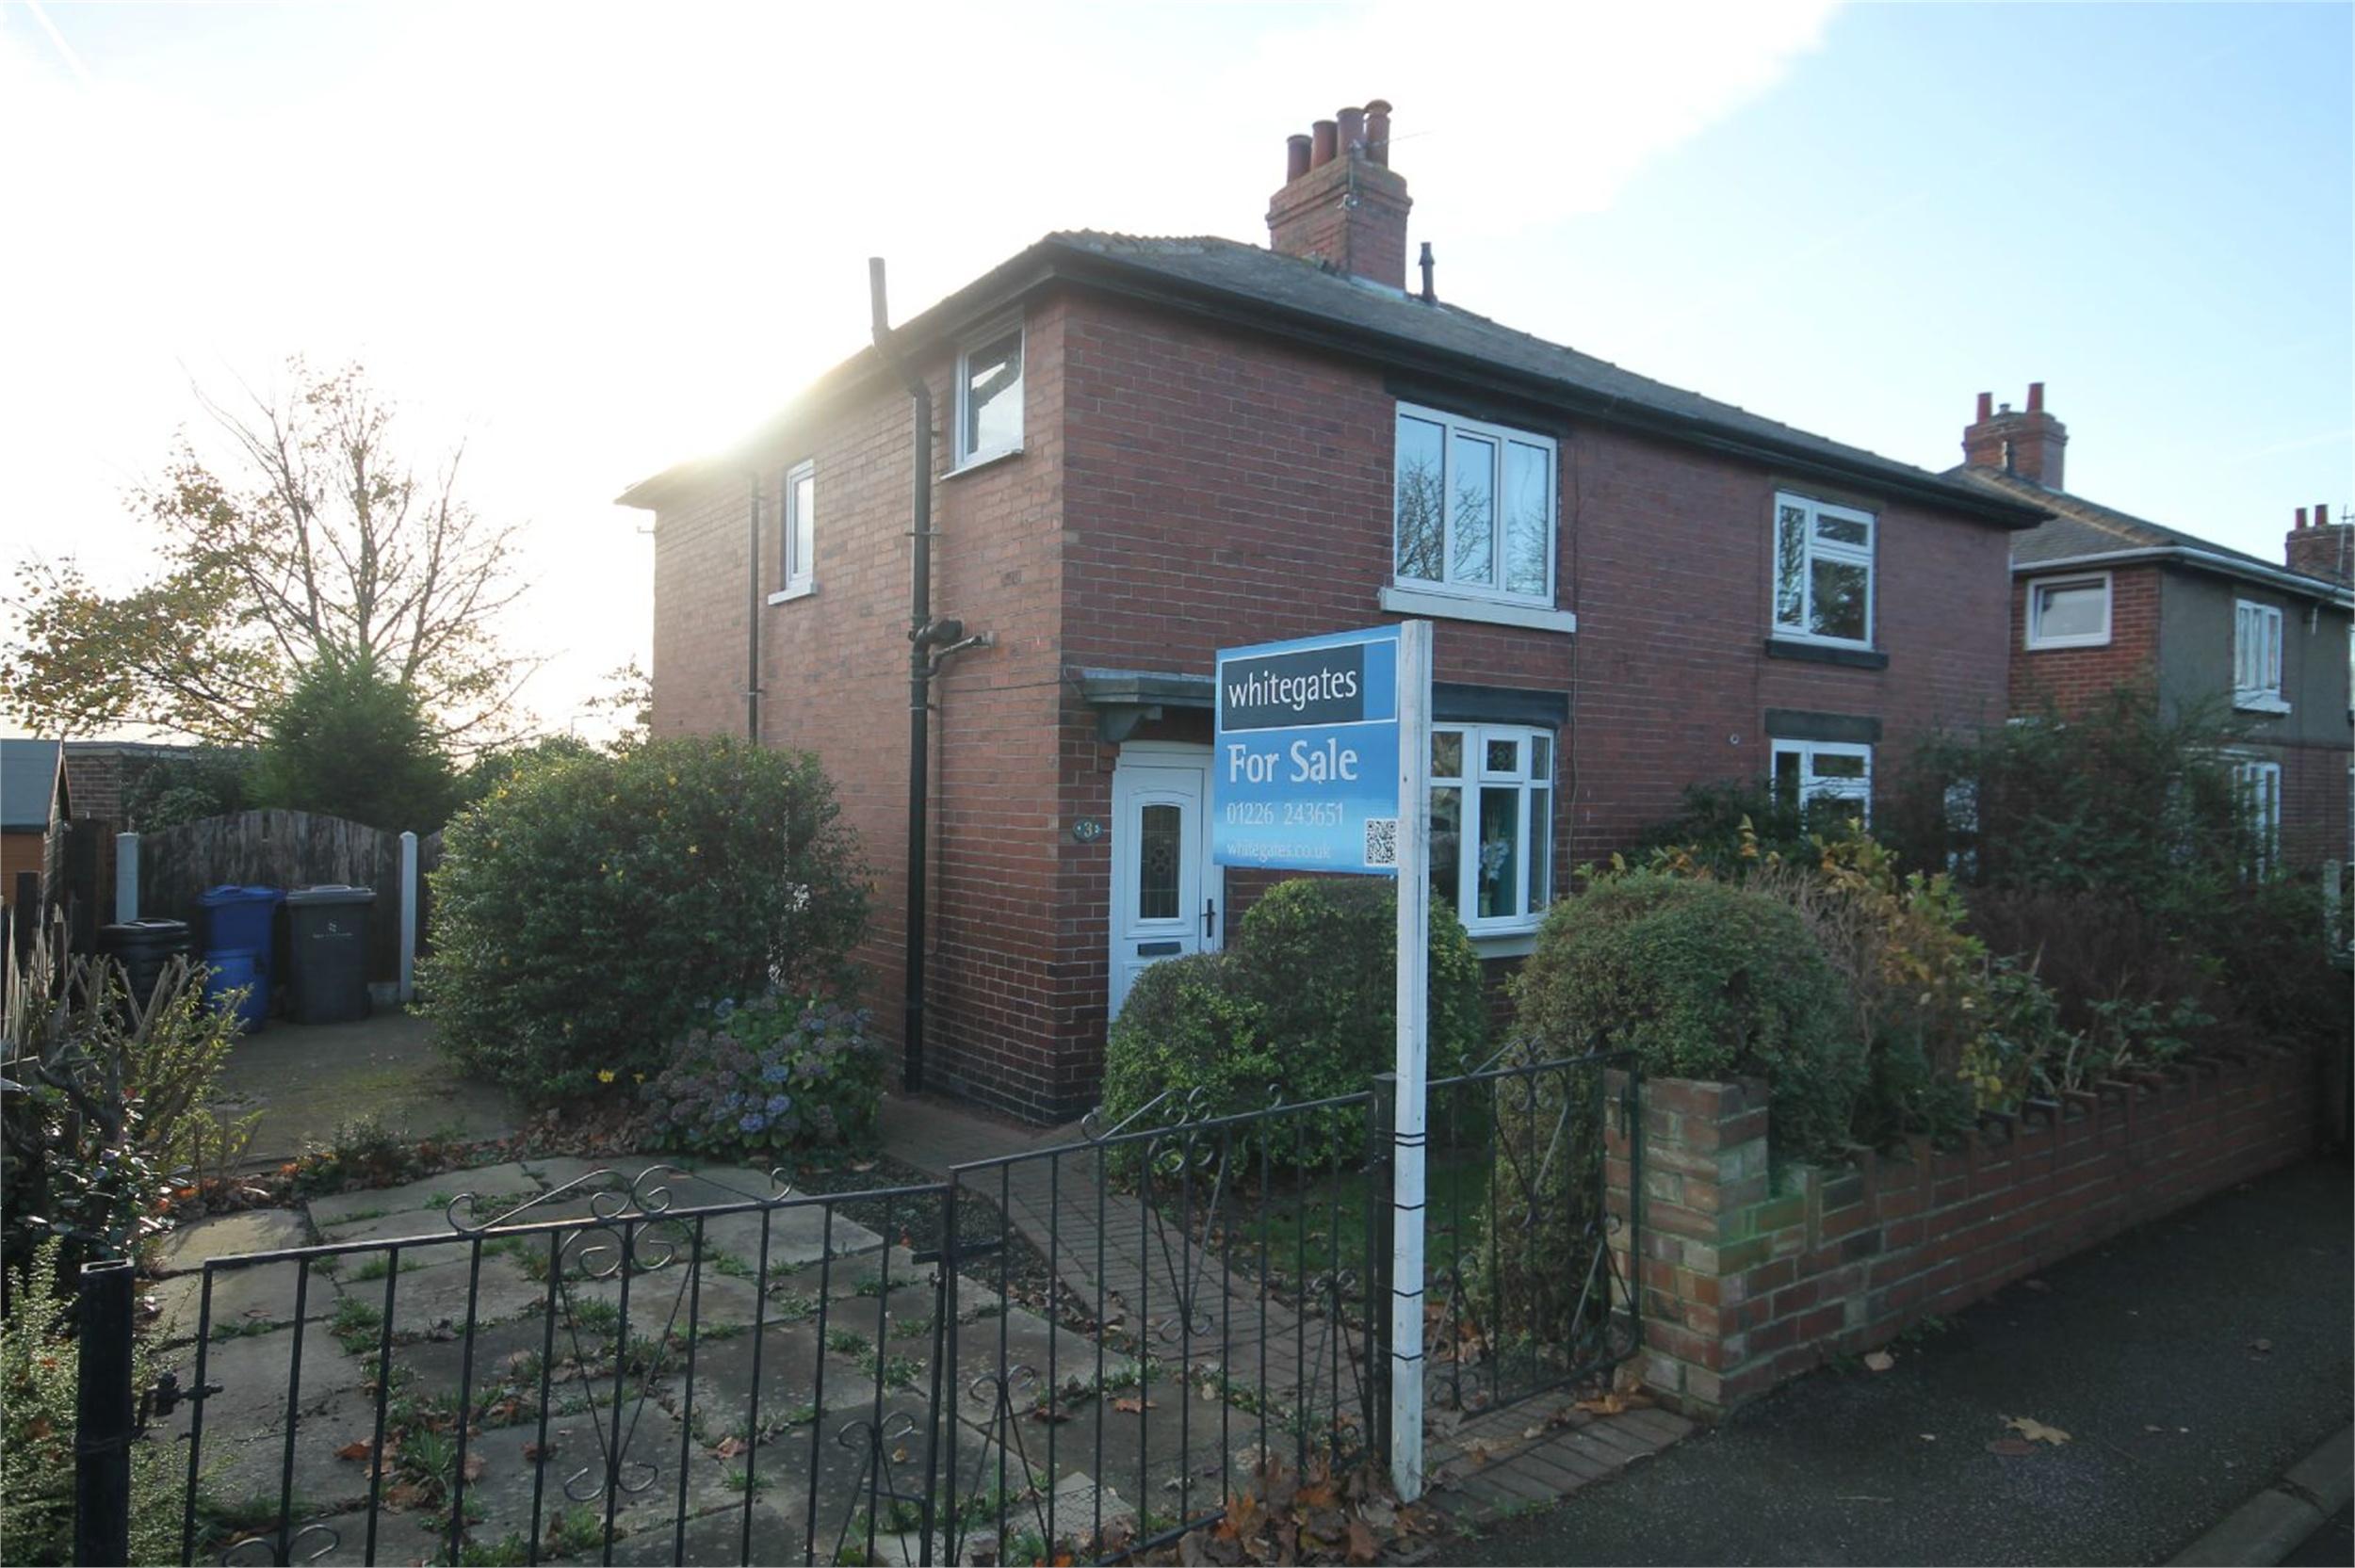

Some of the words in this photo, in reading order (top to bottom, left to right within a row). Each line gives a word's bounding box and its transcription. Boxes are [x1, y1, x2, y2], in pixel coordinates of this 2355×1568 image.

[1227, 667, 1357, 712] whitegates
[1226, 743, 1279, 784] For
[1290, 737, 1357, 783] Sale
[1226, 801, 1275, 826] 01226
[1283, 800, 1344, 827] 243651
[1226, 840, 1332, 863] whitegates.co.uk
